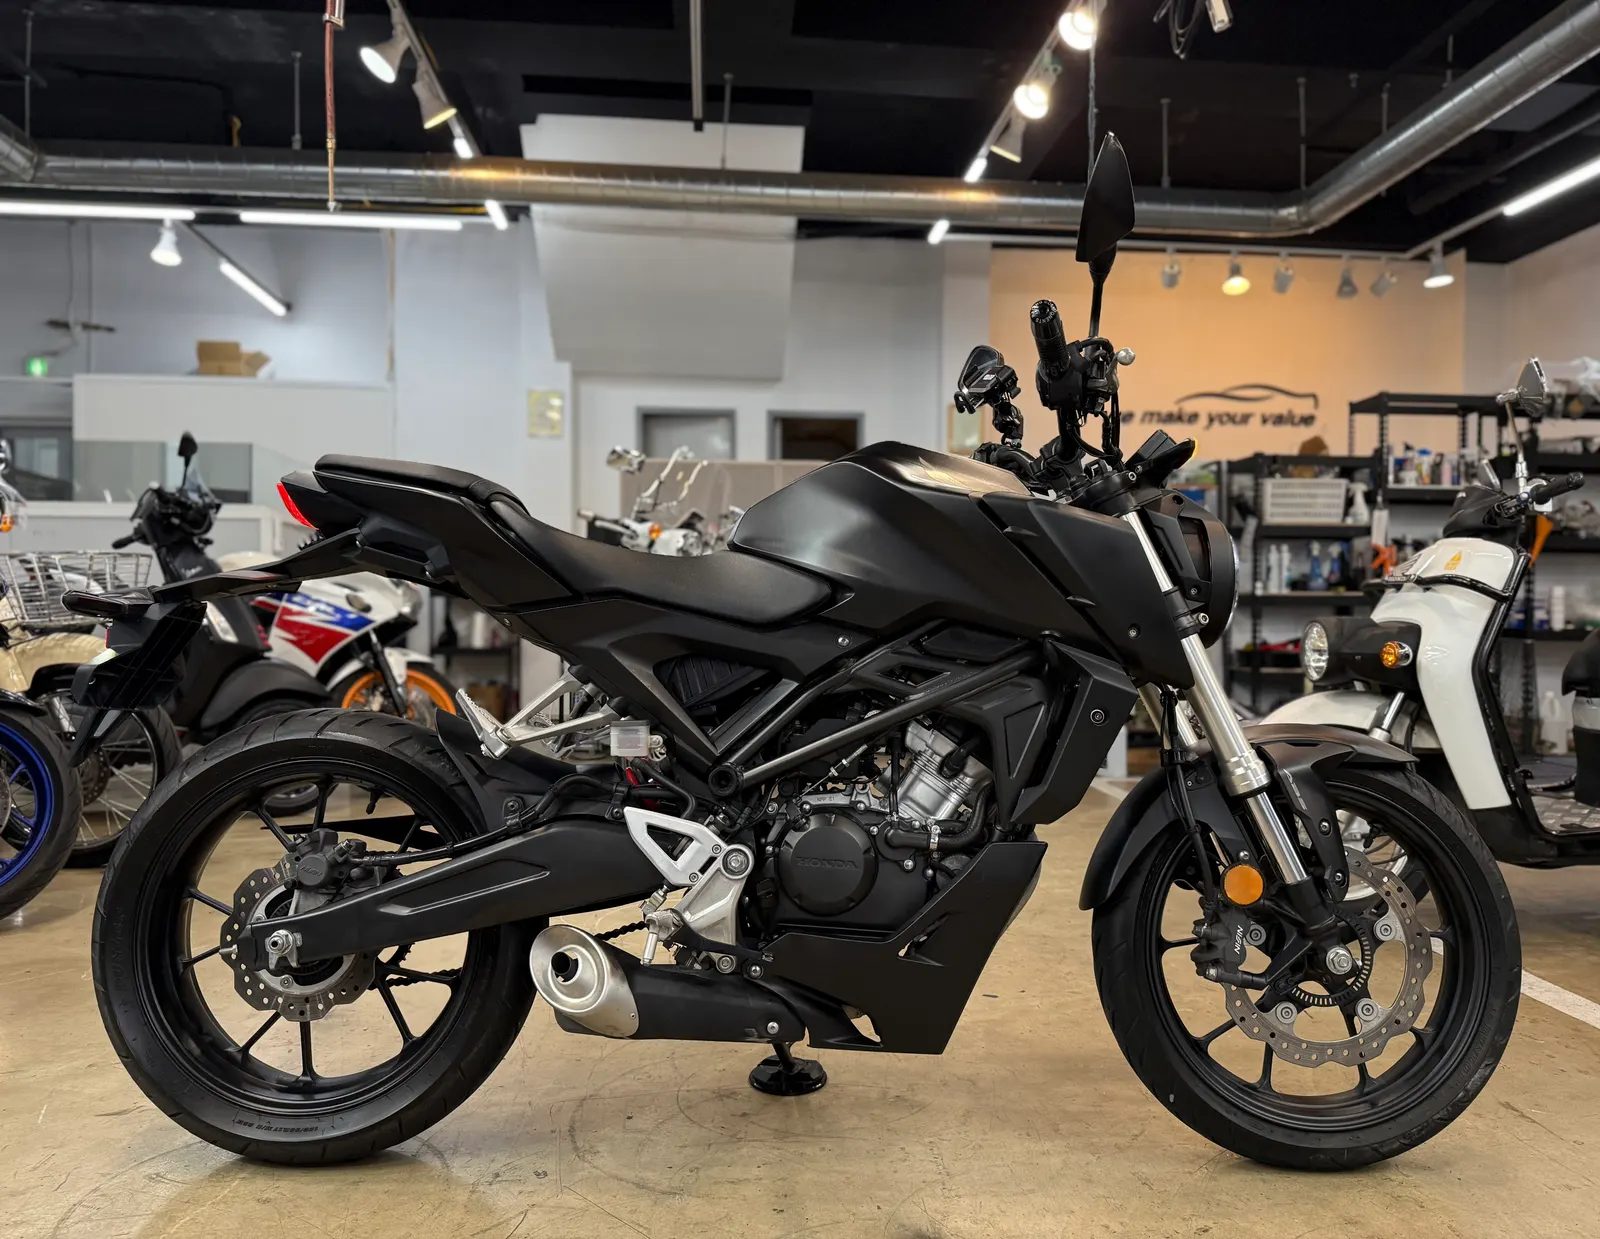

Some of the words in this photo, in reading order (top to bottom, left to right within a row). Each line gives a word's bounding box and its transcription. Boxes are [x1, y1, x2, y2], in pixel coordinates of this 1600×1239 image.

[1140, 408, 1199, 425] make
[1204, 411, 1254, 430] your
[1261, 408, 1316, 427] value
[796, 857, 858, 870] HONDA
